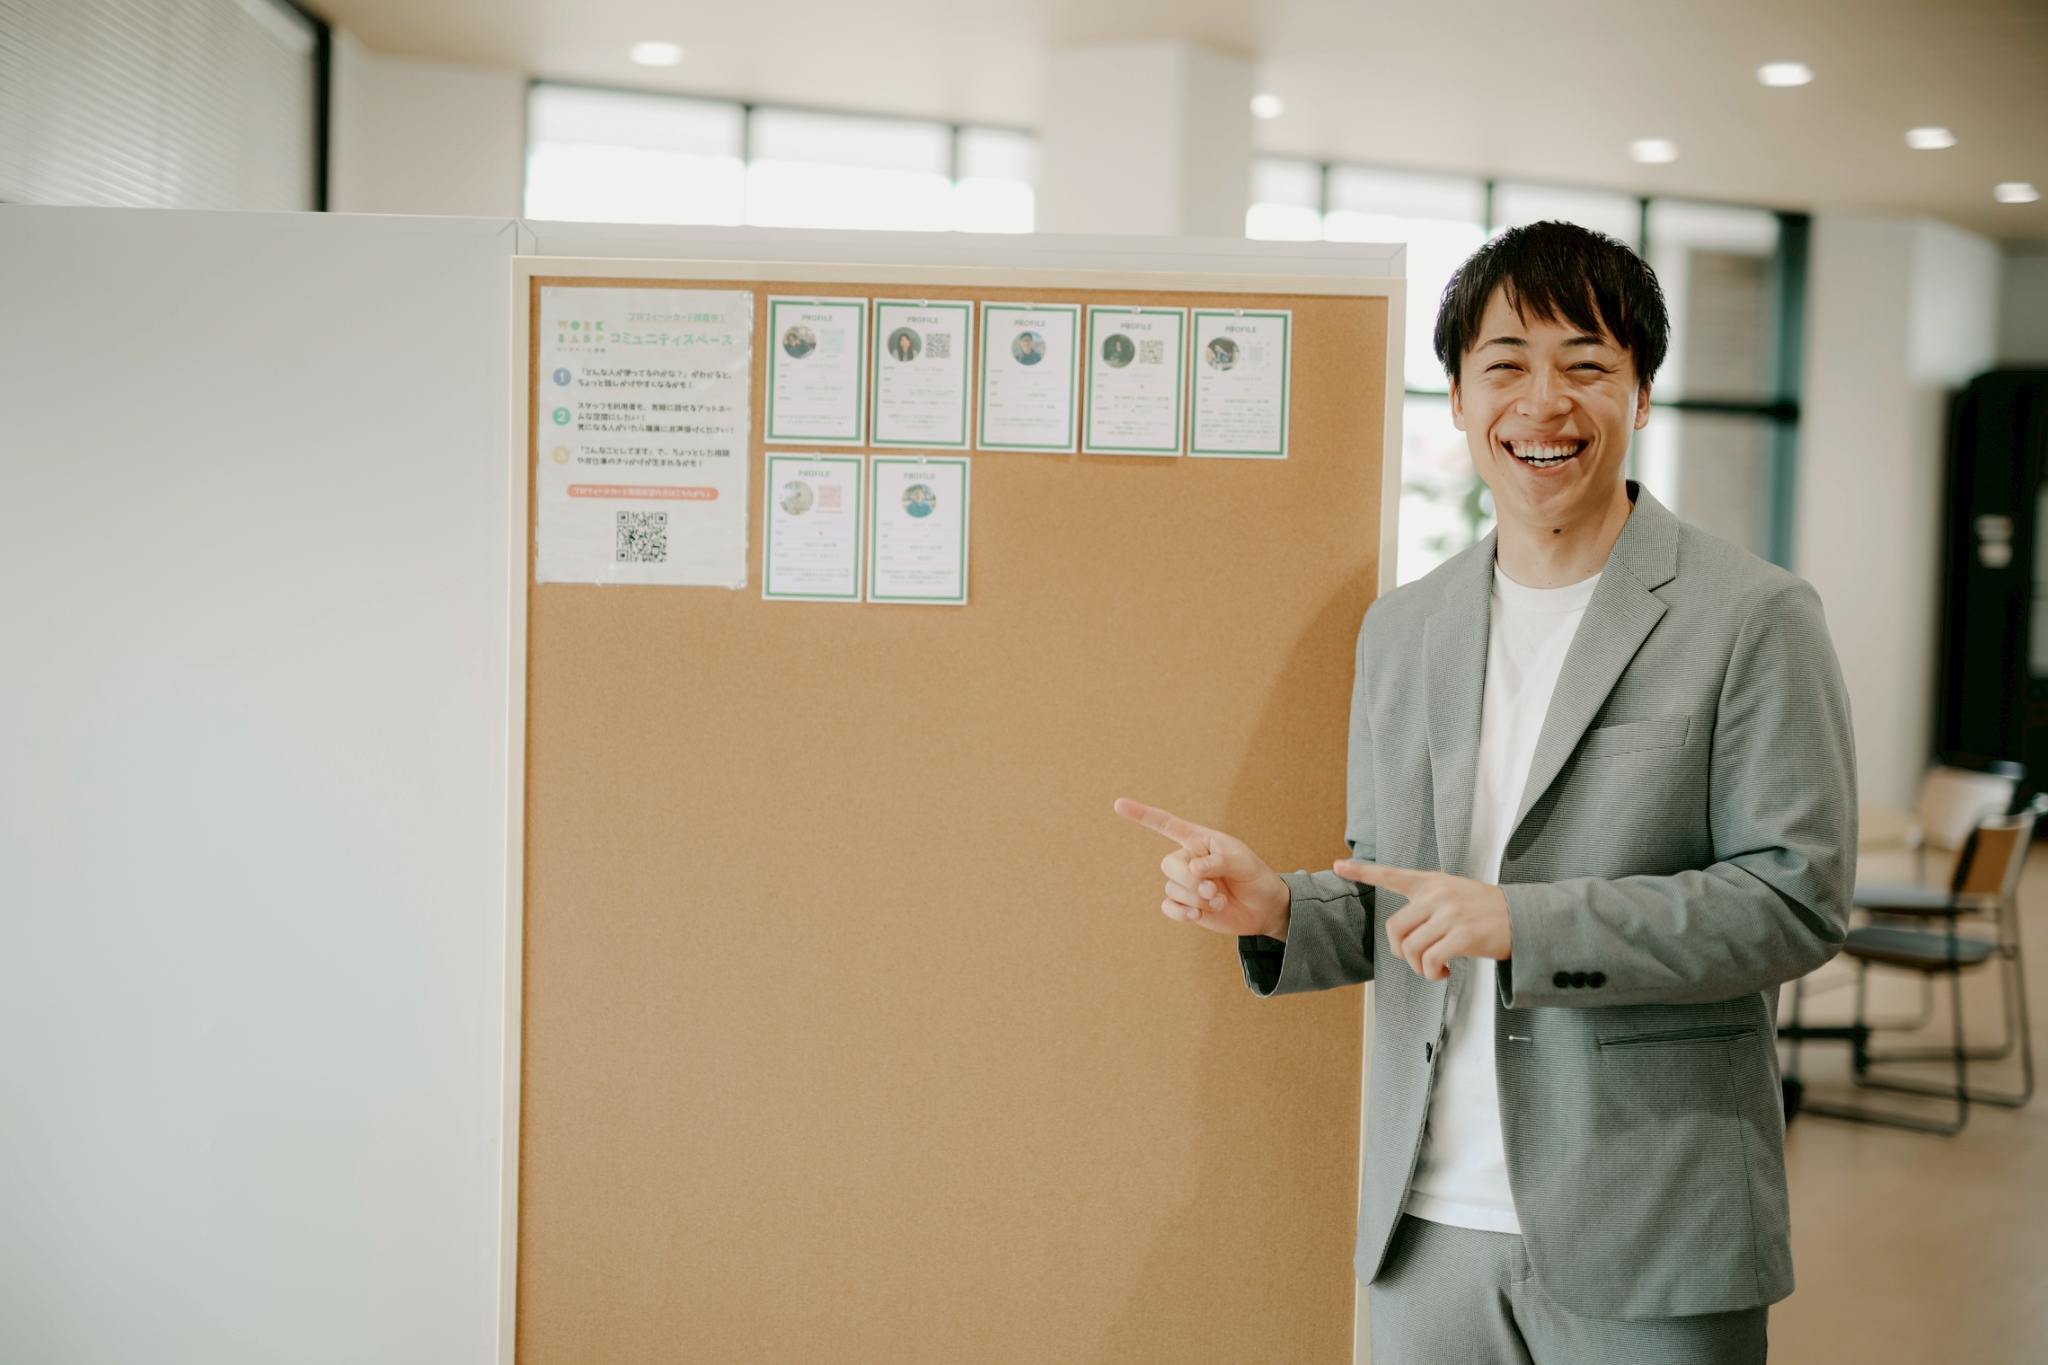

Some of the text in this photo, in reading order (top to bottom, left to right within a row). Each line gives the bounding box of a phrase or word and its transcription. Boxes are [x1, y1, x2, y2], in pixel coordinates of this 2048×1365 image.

[801, 314, 833, 322] PROFILE
[906, 316, 939, 324] PROFILE
[557, 320, 605, 331] WORK
[1013, 319, 1046, 327] PROFILE
[1120, 322, 1152, 330] PROFILE
[1224, 325, 1257, 333] PROFILE
[611, 332, 732, 346] コミュニティスペース
[558, 371, 565, 382] 1
[578, 379, 692, 389] ちょっと話しかけやすくなるかも！
[557, 411, 566, 422] 2
[577, 412, 645, 422] ムな空間にしたい！
[557, 450, 565, 461] 3
[798, 469, 831, 478] PROFILE
[903, 472, 936, 480] PROFILE
